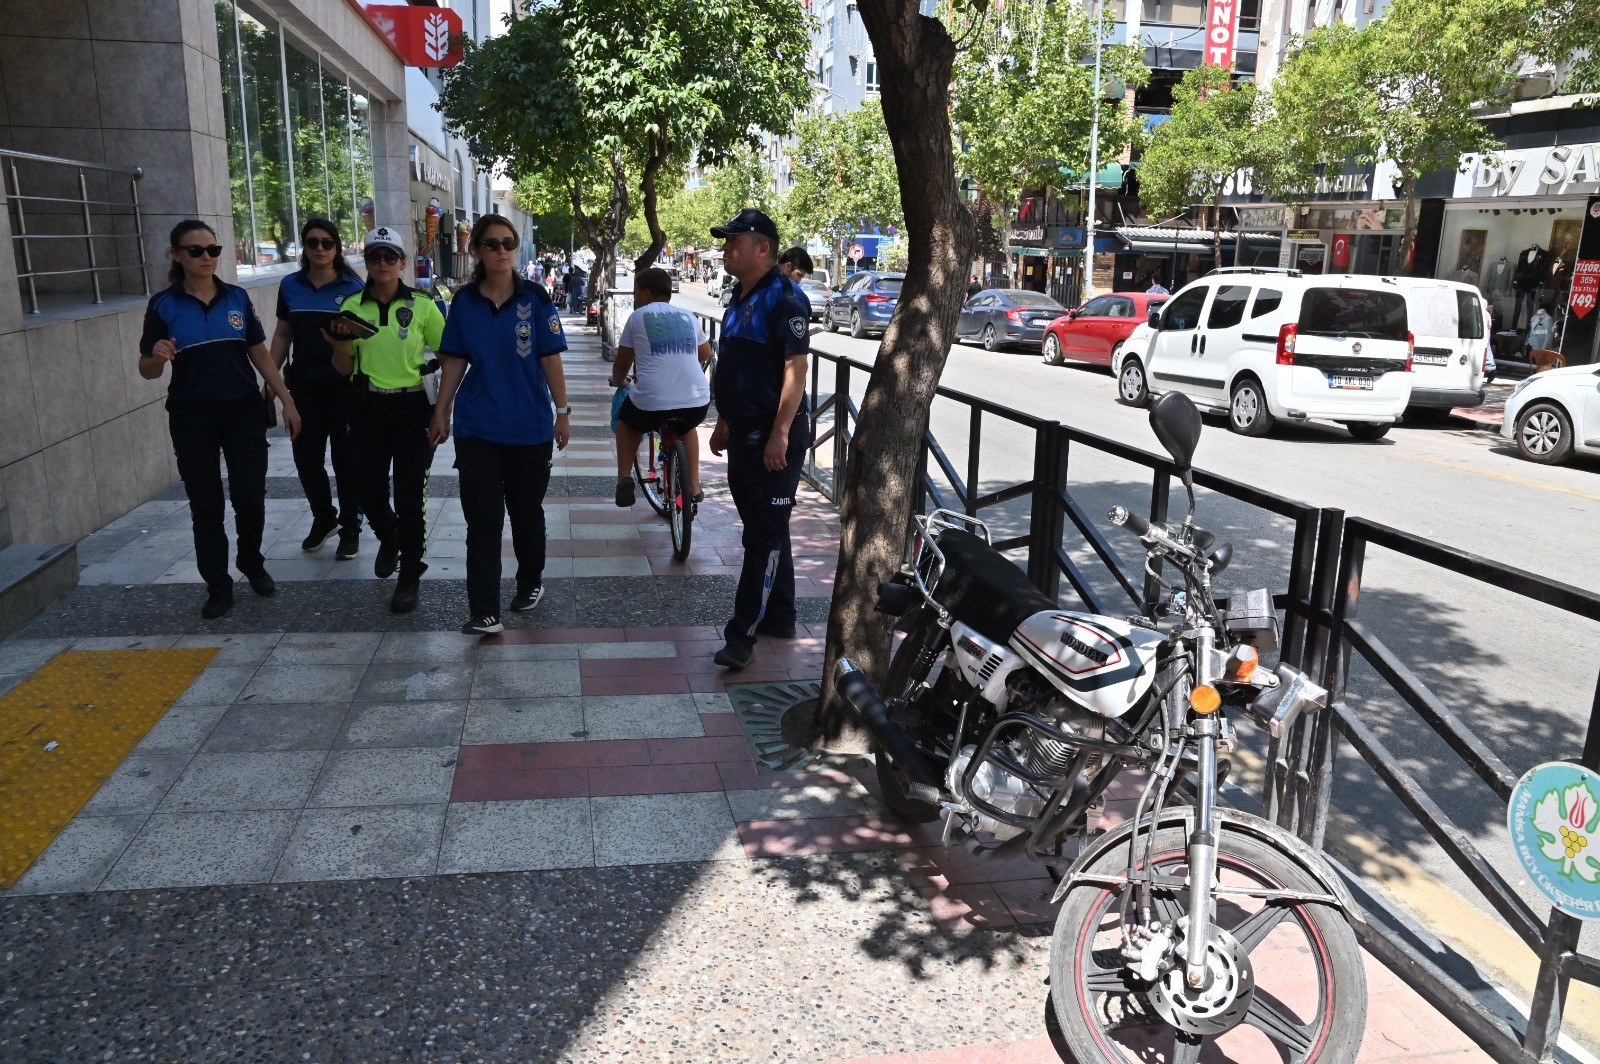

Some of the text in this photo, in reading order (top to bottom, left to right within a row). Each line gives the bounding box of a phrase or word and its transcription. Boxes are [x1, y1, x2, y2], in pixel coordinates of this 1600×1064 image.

[1474, 145, 1600, 196] By SA
[1575, 261, 1600, 275] TİŞÖR
[1571, 293, 1593, 308] 149
[1334, 376, 1342, 385] 10
[1345, 377, 1357, 386] AKL
[1514, 789, 1594, 912] MANİSA BÜYÜKŞEHİR
